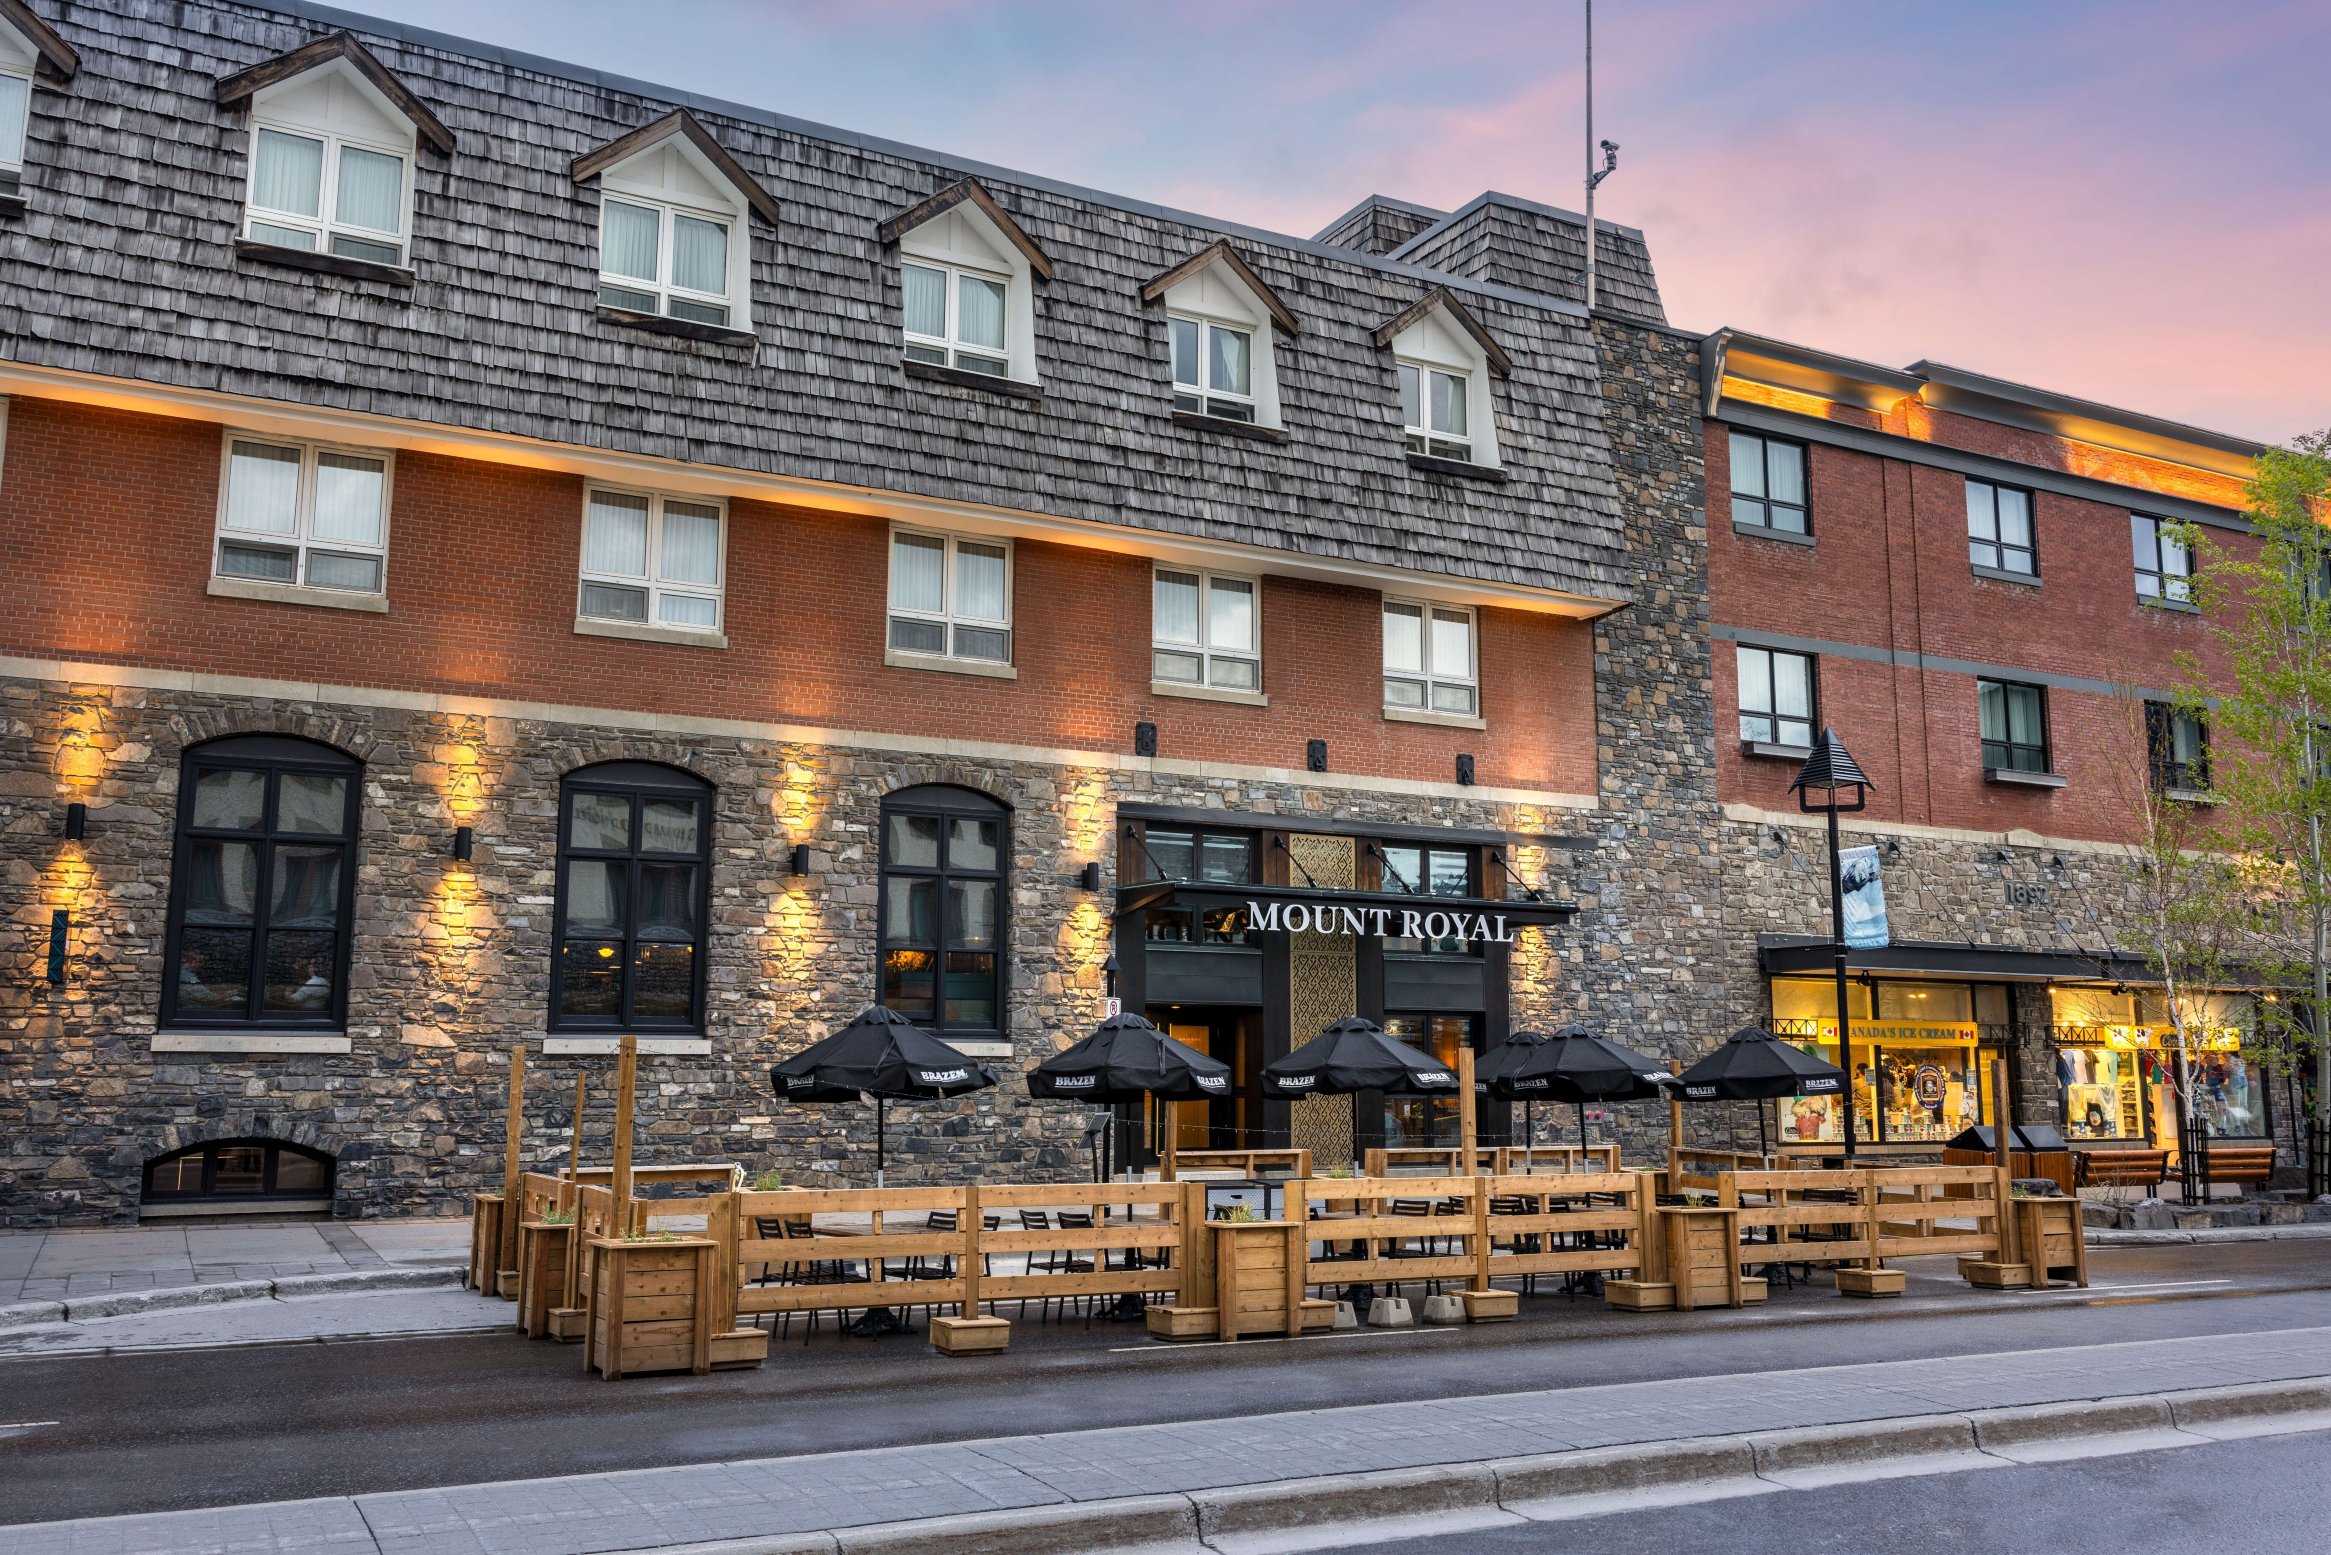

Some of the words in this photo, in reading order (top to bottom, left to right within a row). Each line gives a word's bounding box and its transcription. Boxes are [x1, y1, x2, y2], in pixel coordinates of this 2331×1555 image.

[2005, 883, 2049, 905] 1892
[1247, 901, 1391, 936] MOUNT
[1400, 910, 1514, 943] ROYAL
[1850, 1026, 1896, 1038] ANADA'S
[1899, 1028, 1916, 1039] ICE
[1918, 1029, 1956, 1040] CREAM
[920, 1068, 968, 1081] BRAZEN
[1416, 1072, 1450, 1081] BRAZEN
[1055, 1075, 1096, 1086] BRAZEN
[1196, 1075, 1226, 1086] BRAZEN
[1278, 1075, 1316, 1086] BRAZEN
[1513, 1078, 1549, 1088] BRAZEN
[1805, 1078, 1839, 1088] BRAZEN
[1686, 1086, 1717, 1095] BRAZEN
